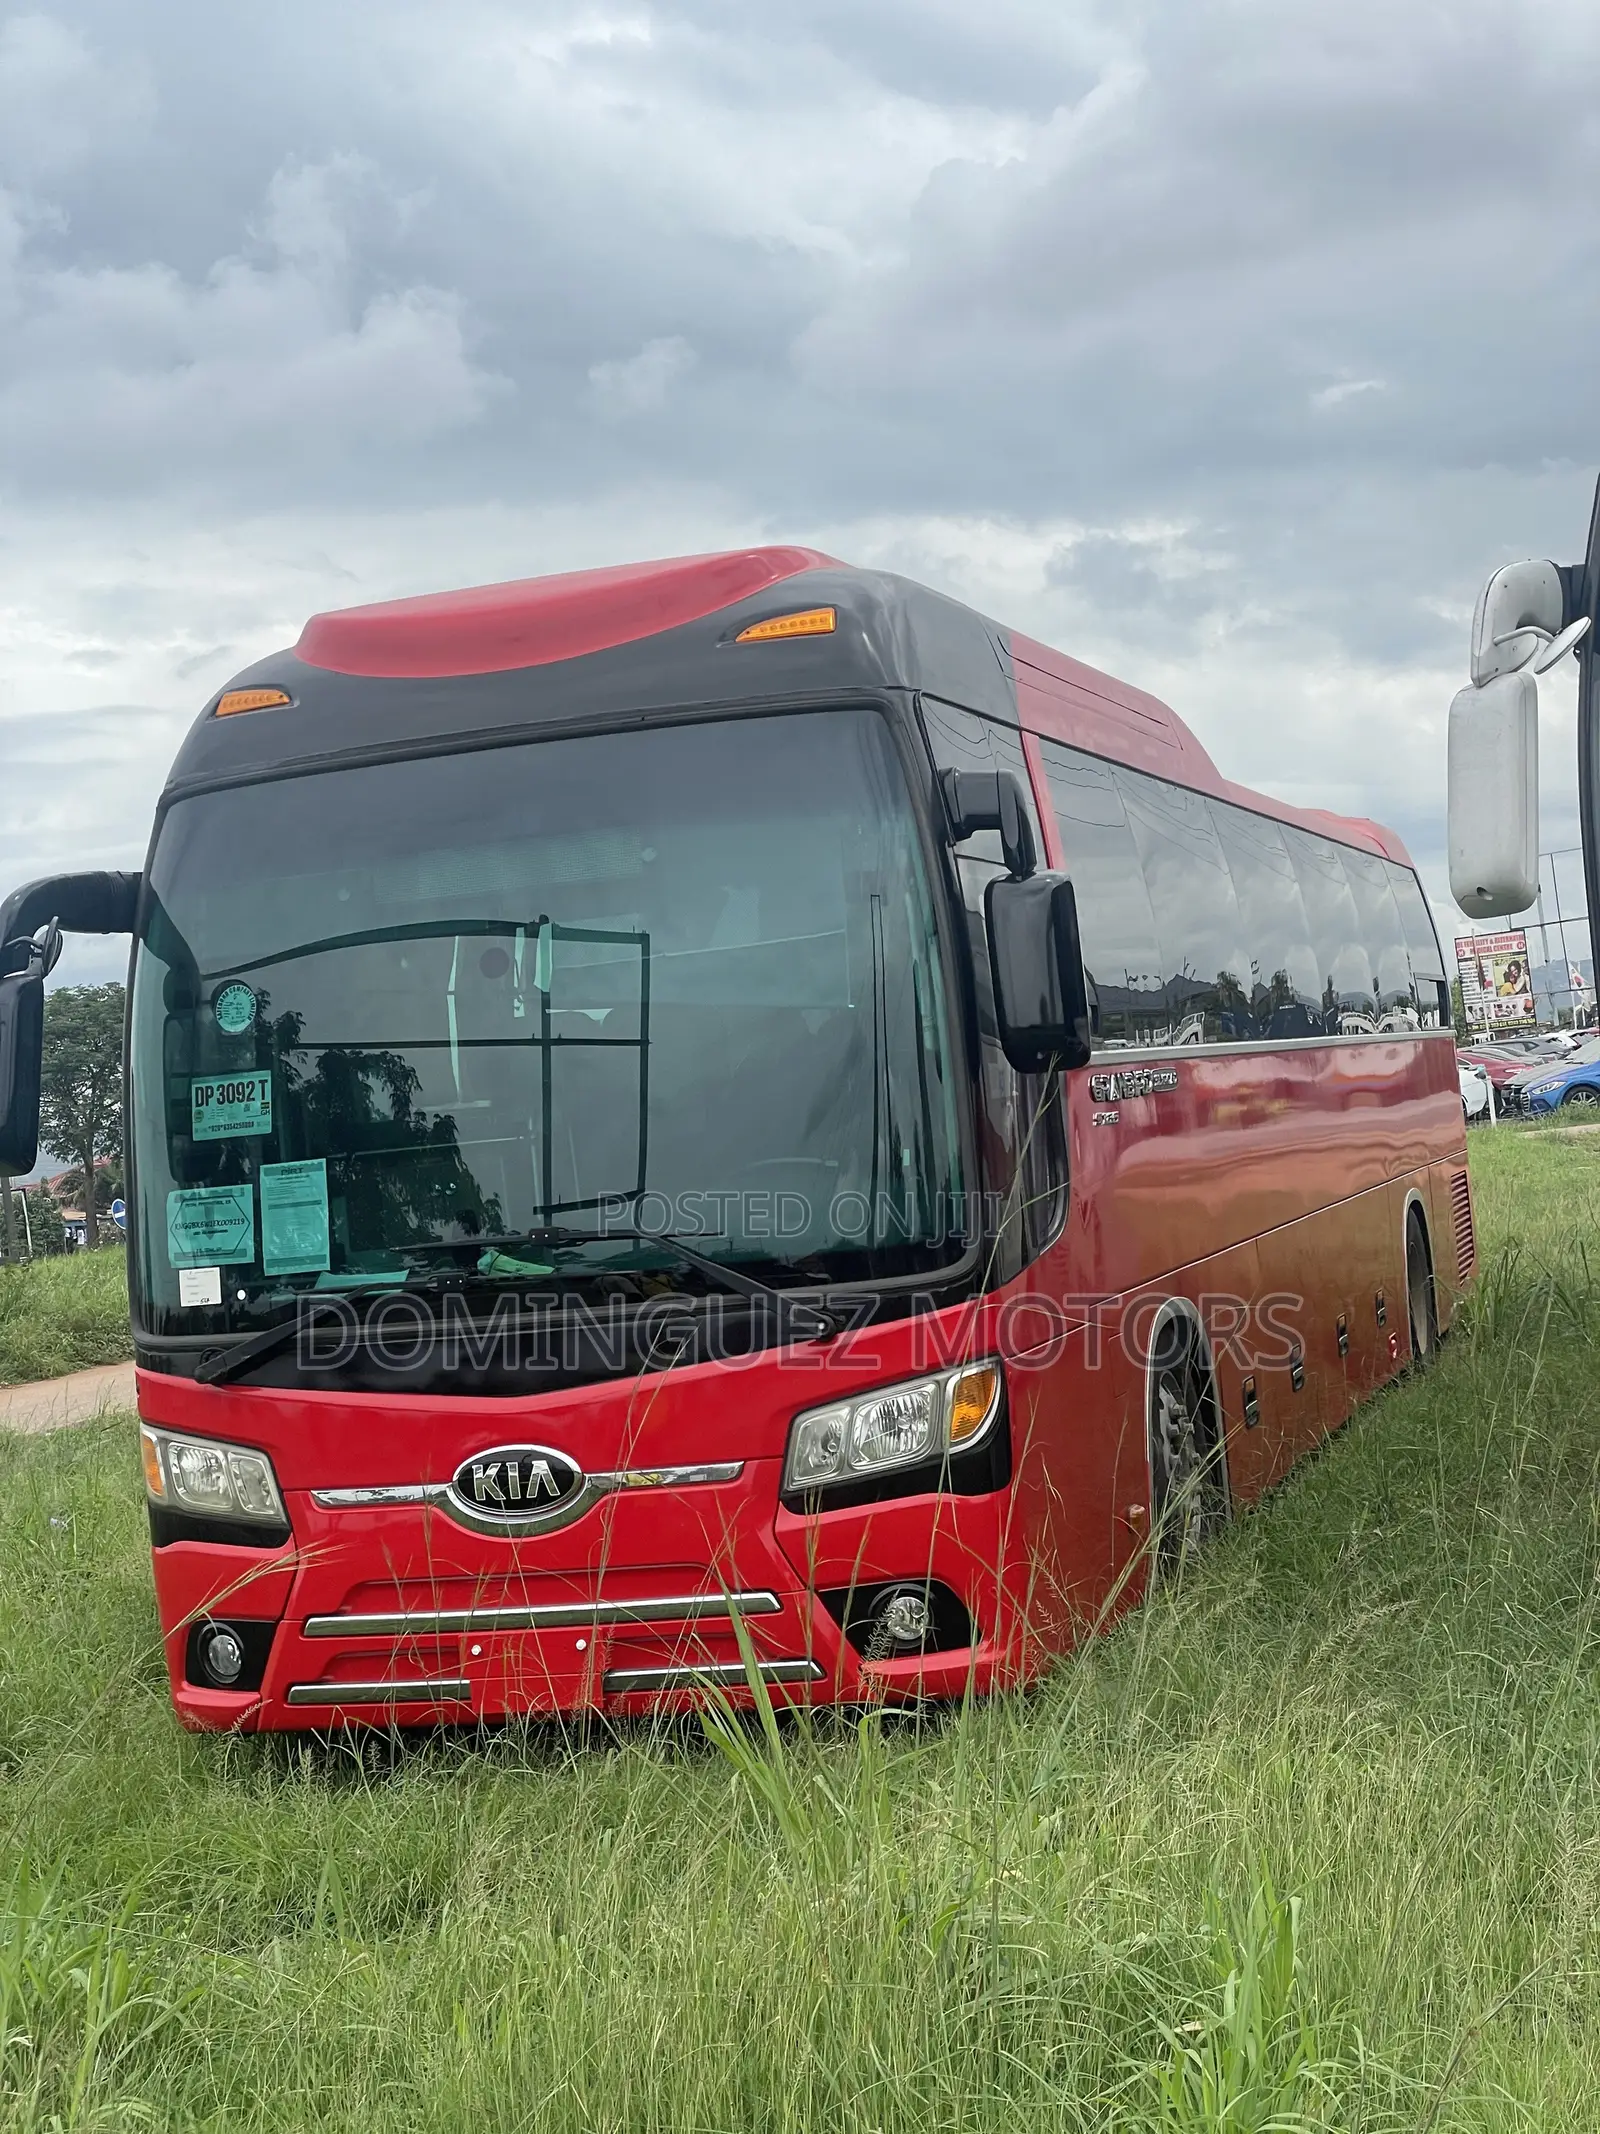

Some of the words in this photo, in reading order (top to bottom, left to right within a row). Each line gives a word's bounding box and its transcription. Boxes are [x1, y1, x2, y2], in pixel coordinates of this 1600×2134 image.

[195, 1085, 214, 1108] DP
[216, 1080, 256, 1105] 3092
[258, 1078, 269, 1101] T
[471, 1459, 561, 1501] KIA
